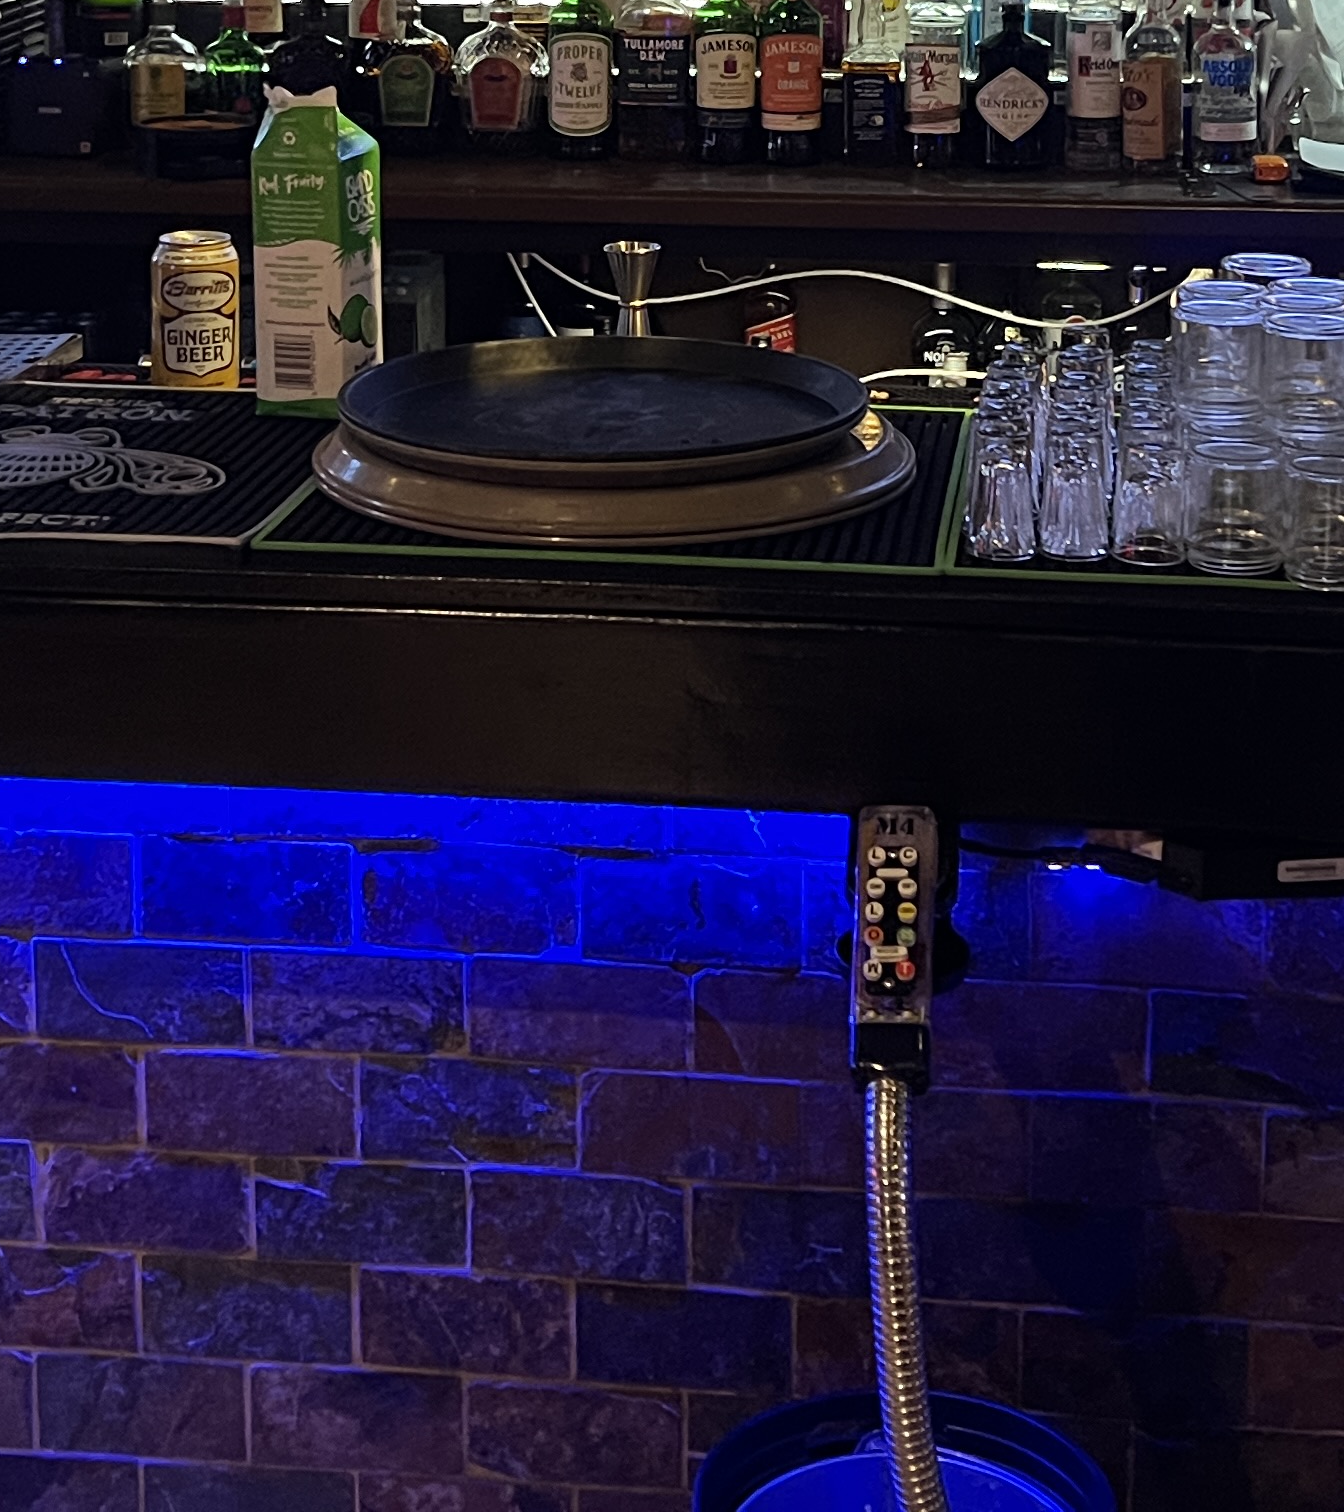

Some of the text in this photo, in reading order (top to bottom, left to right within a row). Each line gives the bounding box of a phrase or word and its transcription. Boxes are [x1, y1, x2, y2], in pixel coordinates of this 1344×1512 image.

[623, 38, 684, 51] TULLAMORE
[701, 39, 755, 55] JAMESON
[765, 41, 821, 58] JAMESON
[557, 45, 603, 62] PROPER
[557, 81, 602, 98] TWELVE
[980, 99, 1045, 110] HENDRICK'S
[283, 173, 326, 194] Fruity
[167, 327, 233, 346] GINGER
[176, 345, 225, 364] BEER
